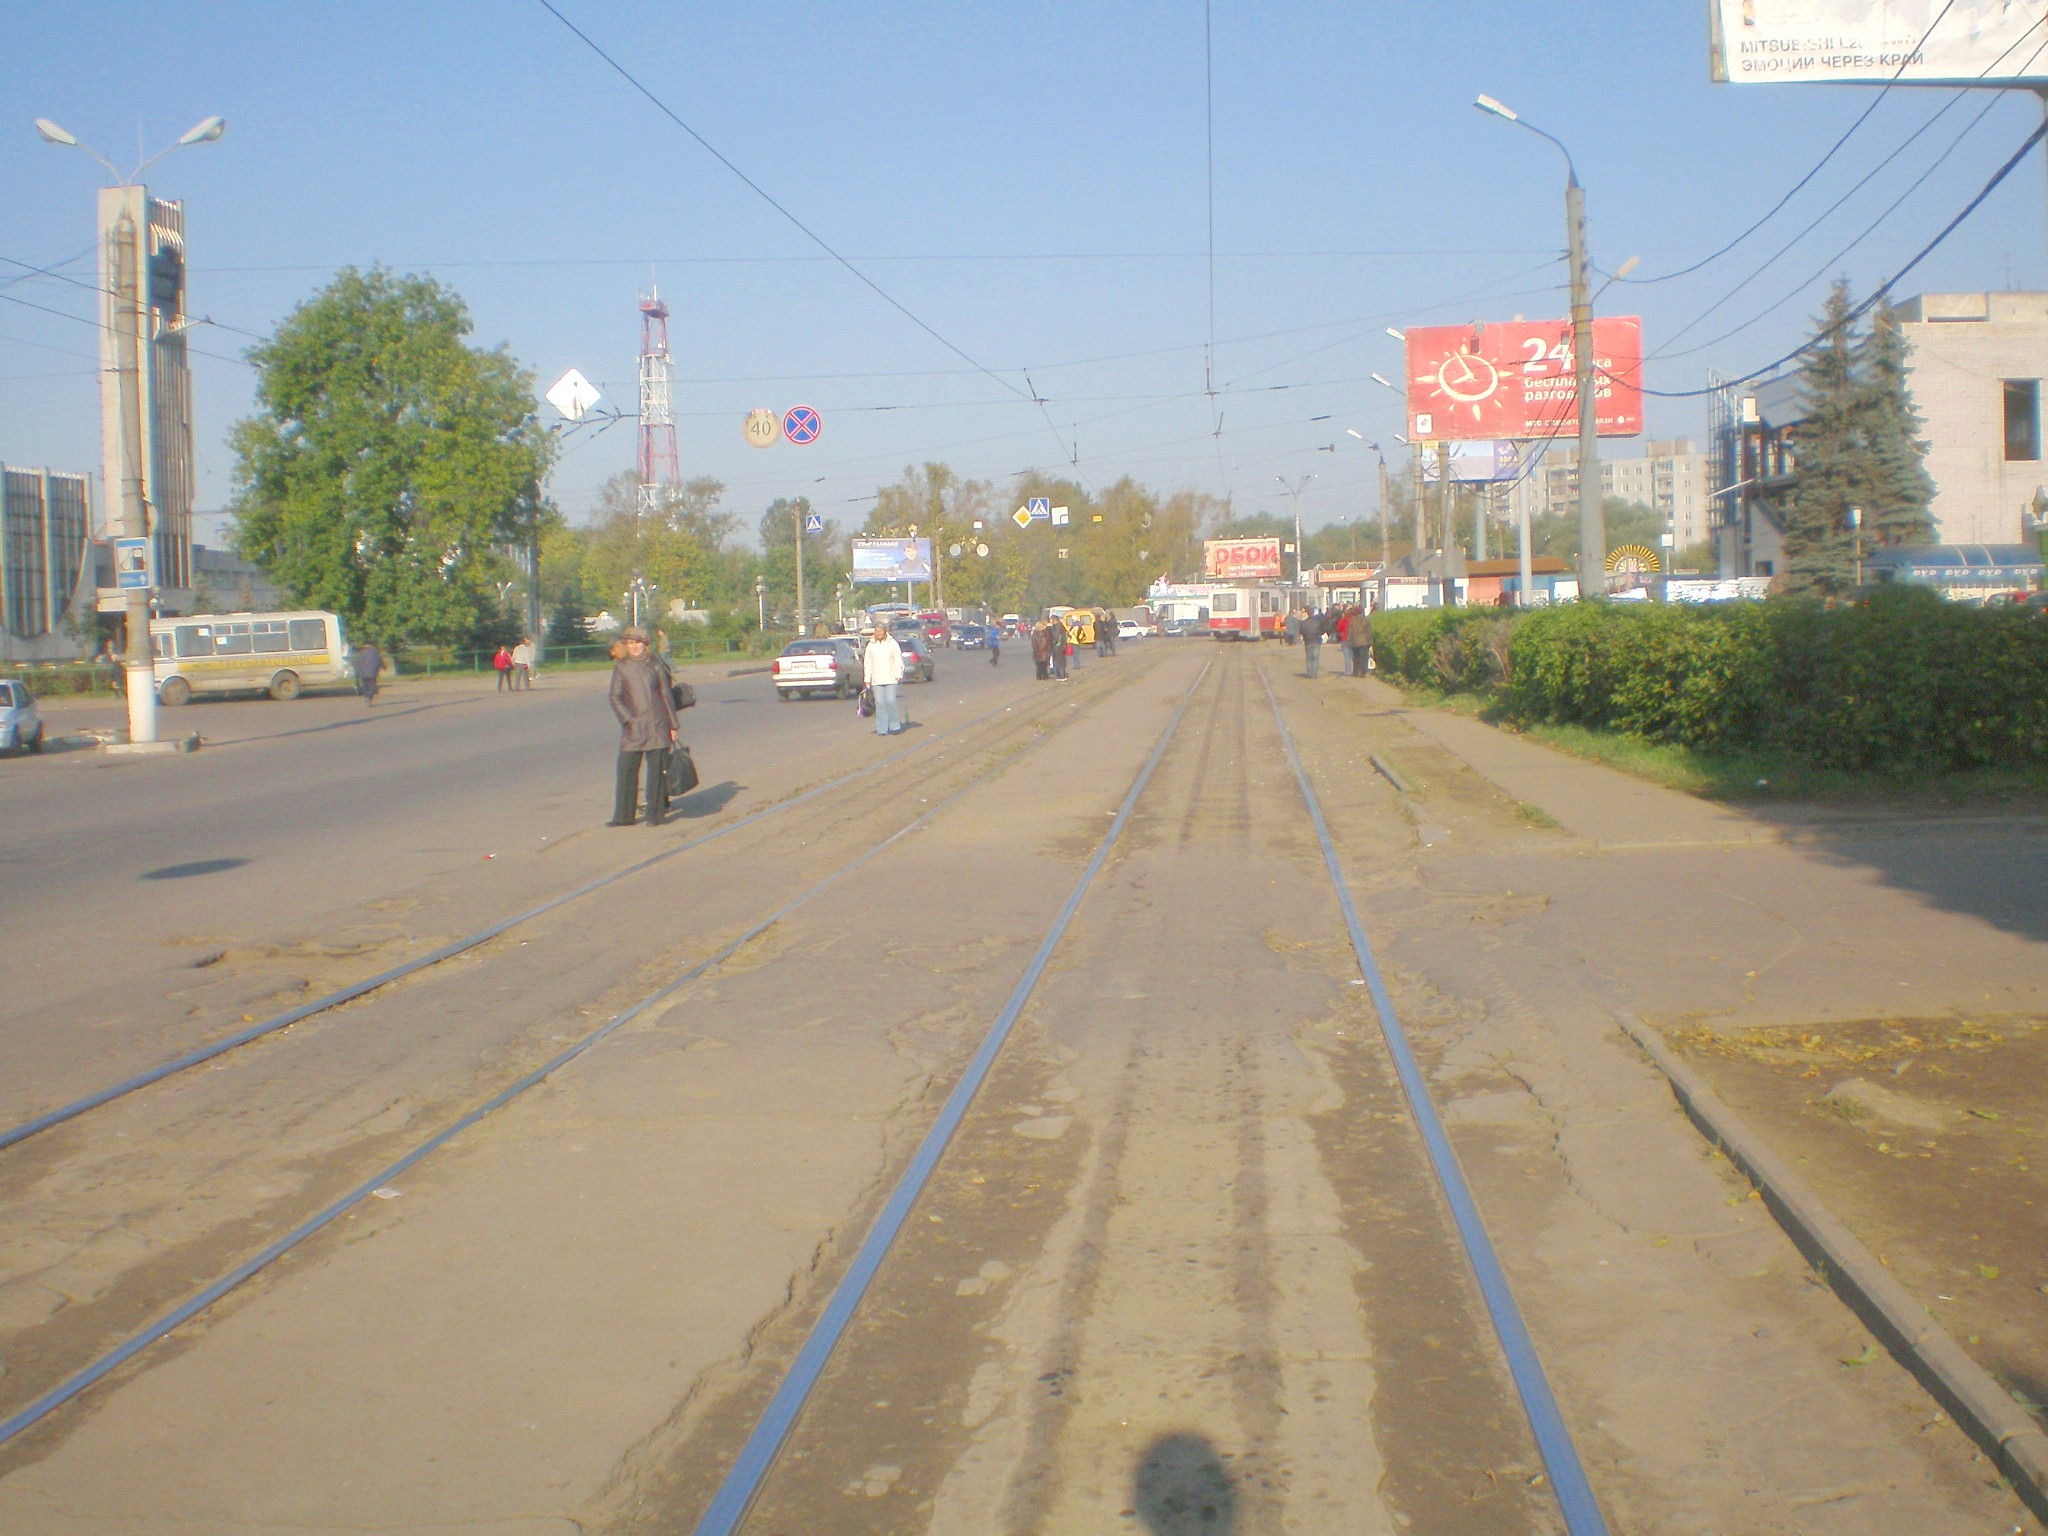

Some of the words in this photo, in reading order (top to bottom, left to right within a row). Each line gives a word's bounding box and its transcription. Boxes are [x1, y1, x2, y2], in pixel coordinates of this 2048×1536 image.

[1821, 55, 1874, 68] ЧЕРЕЗ
[1879, 51, 1924, 66] КРАЙ
[1522, 337, 1575, 372] 24
[750, 420, 771, 436] 40
[1214, 546, 1278, 564] ОБОИ
[1945, 569, 1970, 577] DVD
[1978, 569, 2002, 577] DVD
[2014, 568, 2038, 576] DVD
